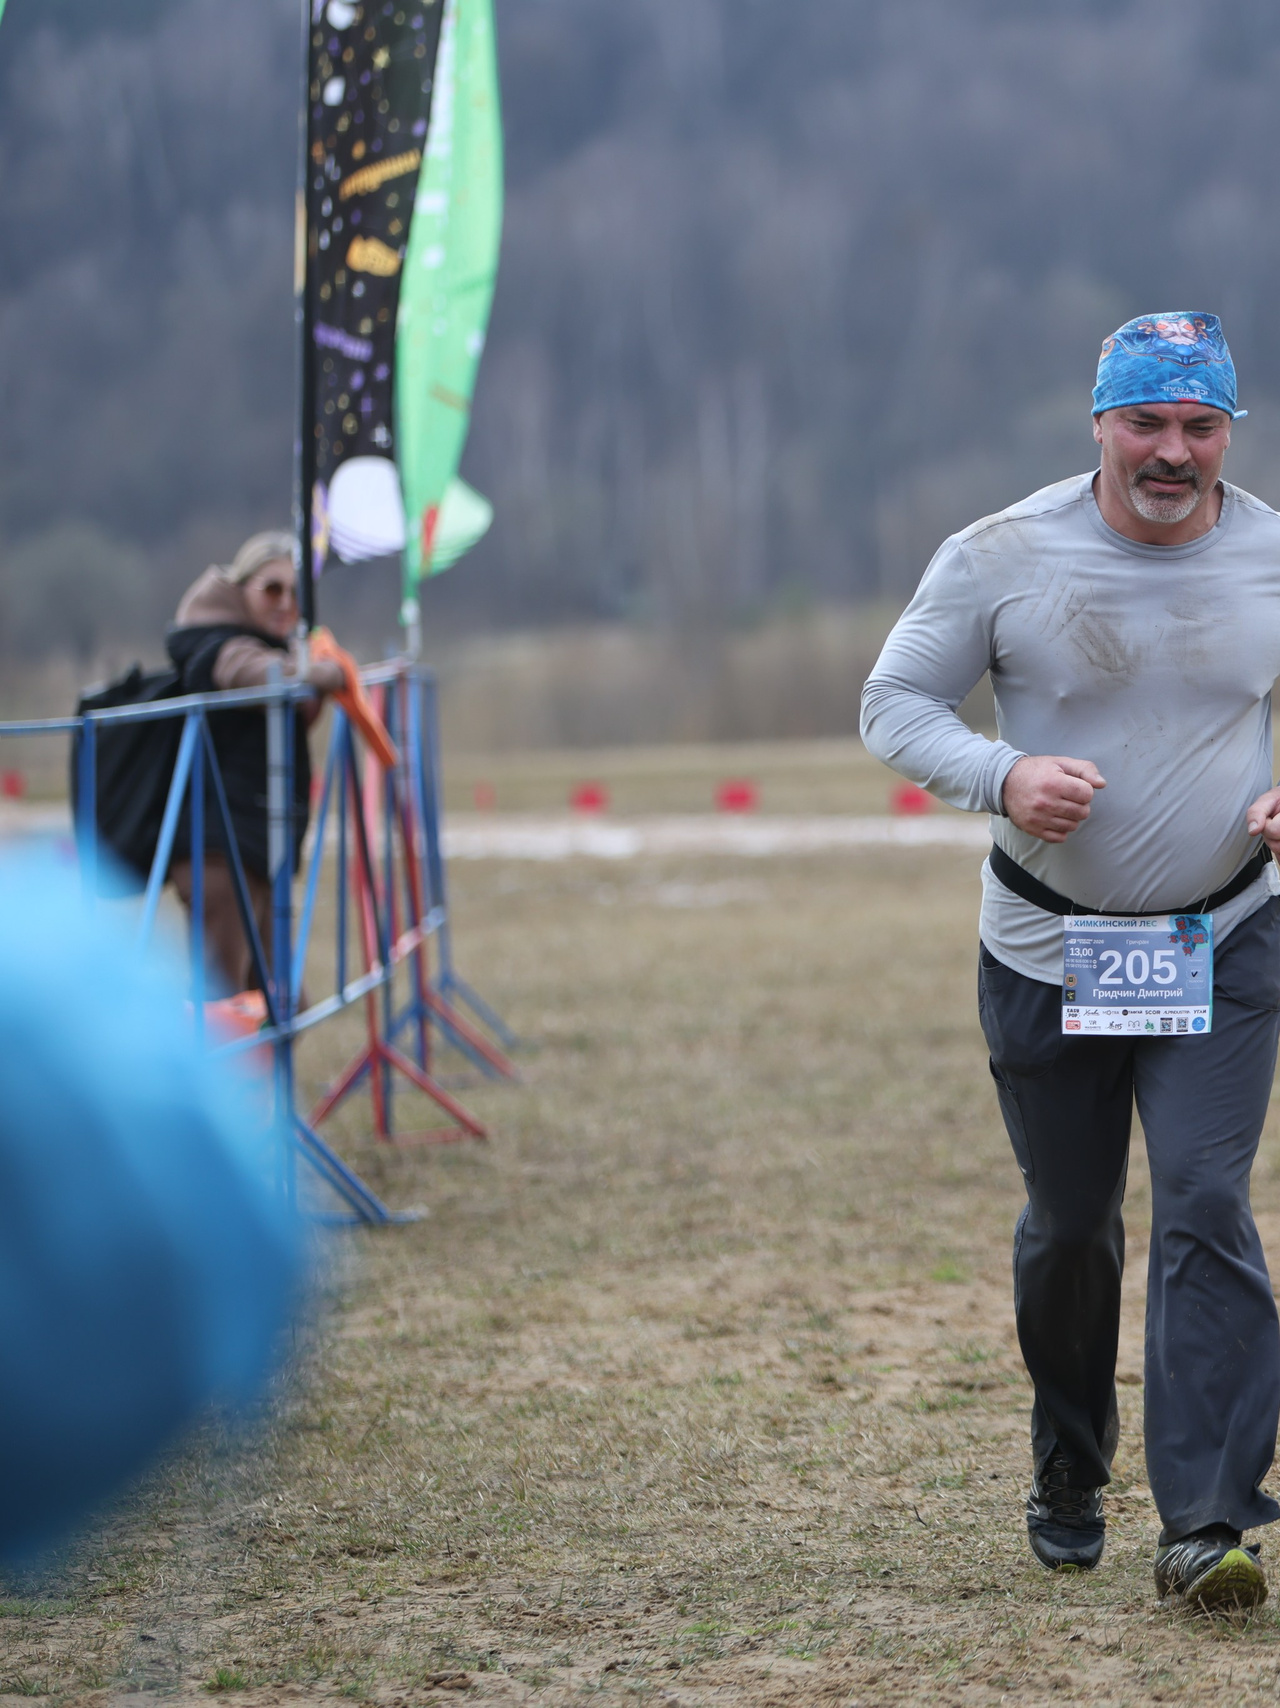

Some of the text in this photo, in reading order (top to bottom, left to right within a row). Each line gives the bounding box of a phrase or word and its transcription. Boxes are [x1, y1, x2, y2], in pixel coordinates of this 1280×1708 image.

[1074, 919, 1157, 928] ХИМКИНСКИЙ ЛЕС
[1069, 947, 1093, 958] 13,00
[1099, 949, 1177, 985] 205
[1093, 988, 1183, 999] Гридчин Дмитрий
